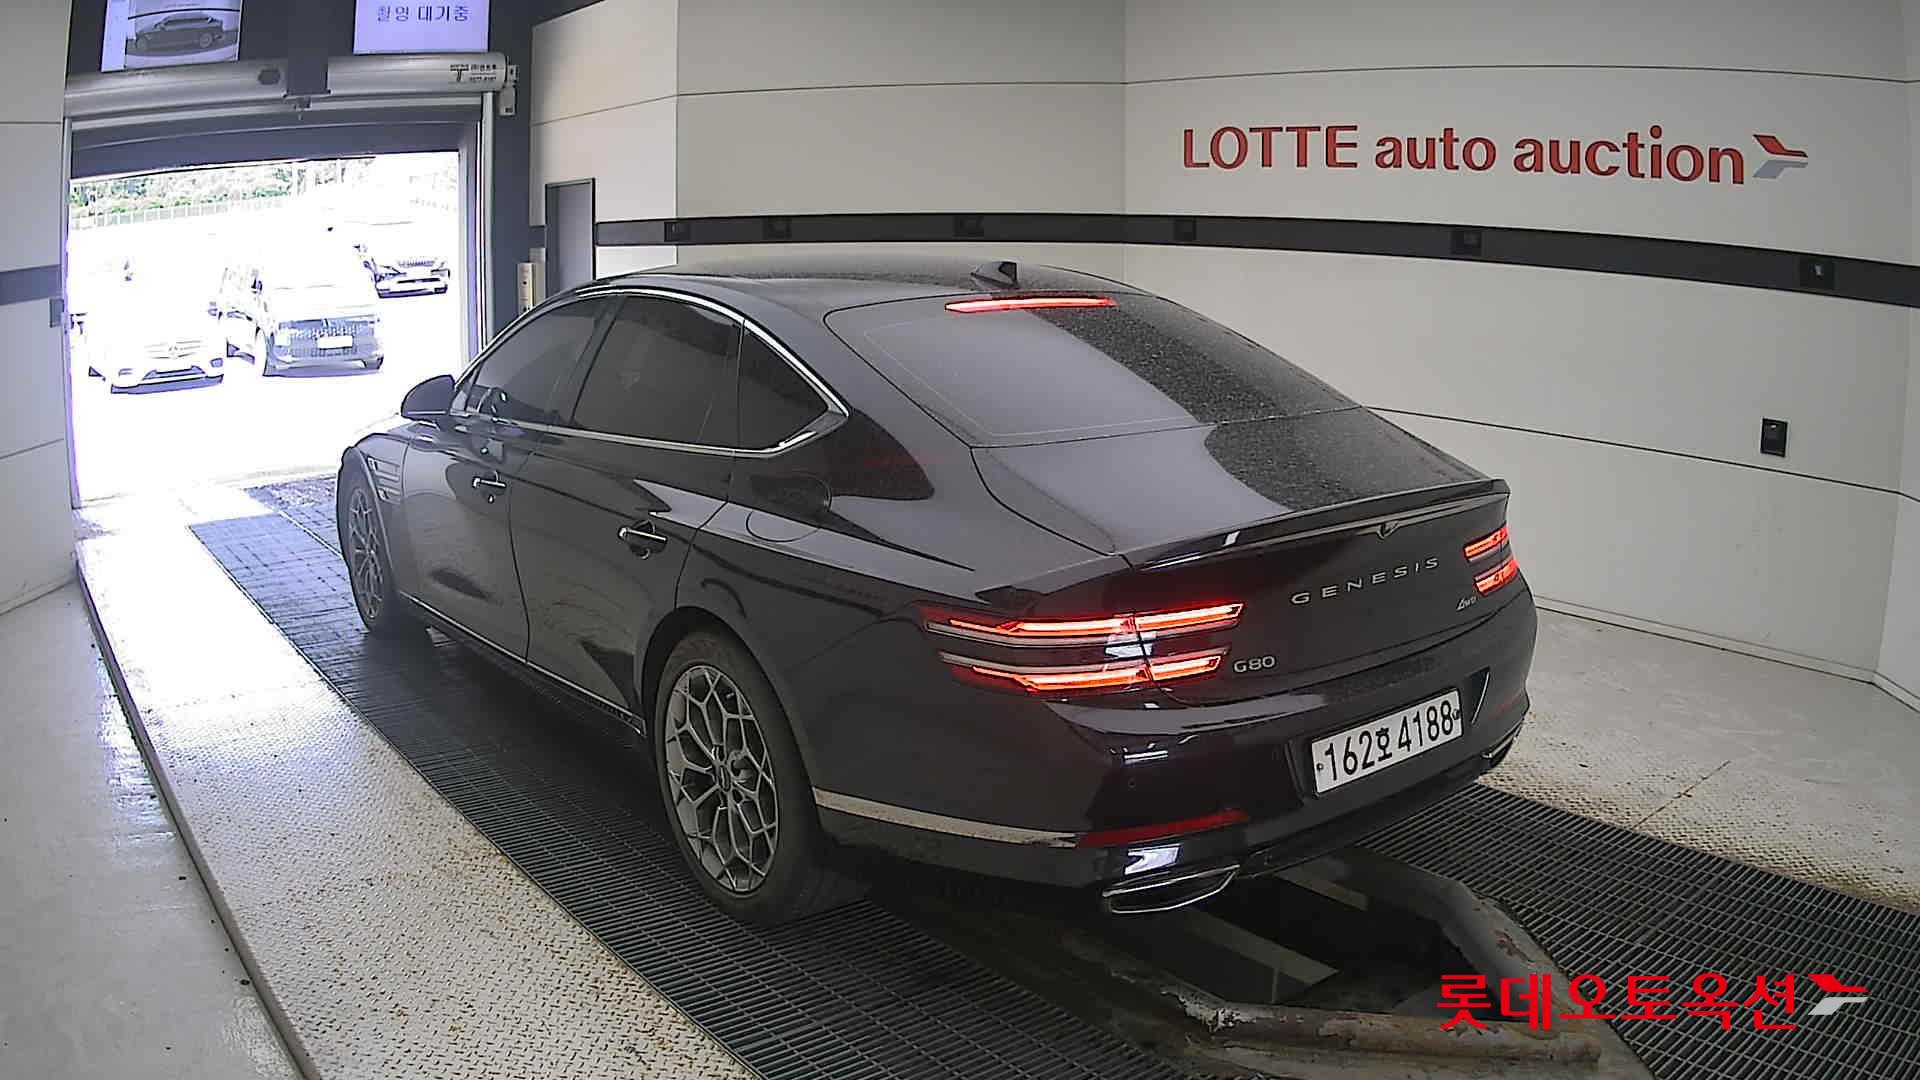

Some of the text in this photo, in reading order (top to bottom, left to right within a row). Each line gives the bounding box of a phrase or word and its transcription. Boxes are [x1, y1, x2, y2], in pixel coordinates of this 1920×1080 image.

[418, 5, 470, 22] 대기중
[1183, 124, 1745, 185] LOTTE auto auction
[1291, 557, 1439, 604] GENESIS
[1233, 655, 1276, 673] G80
